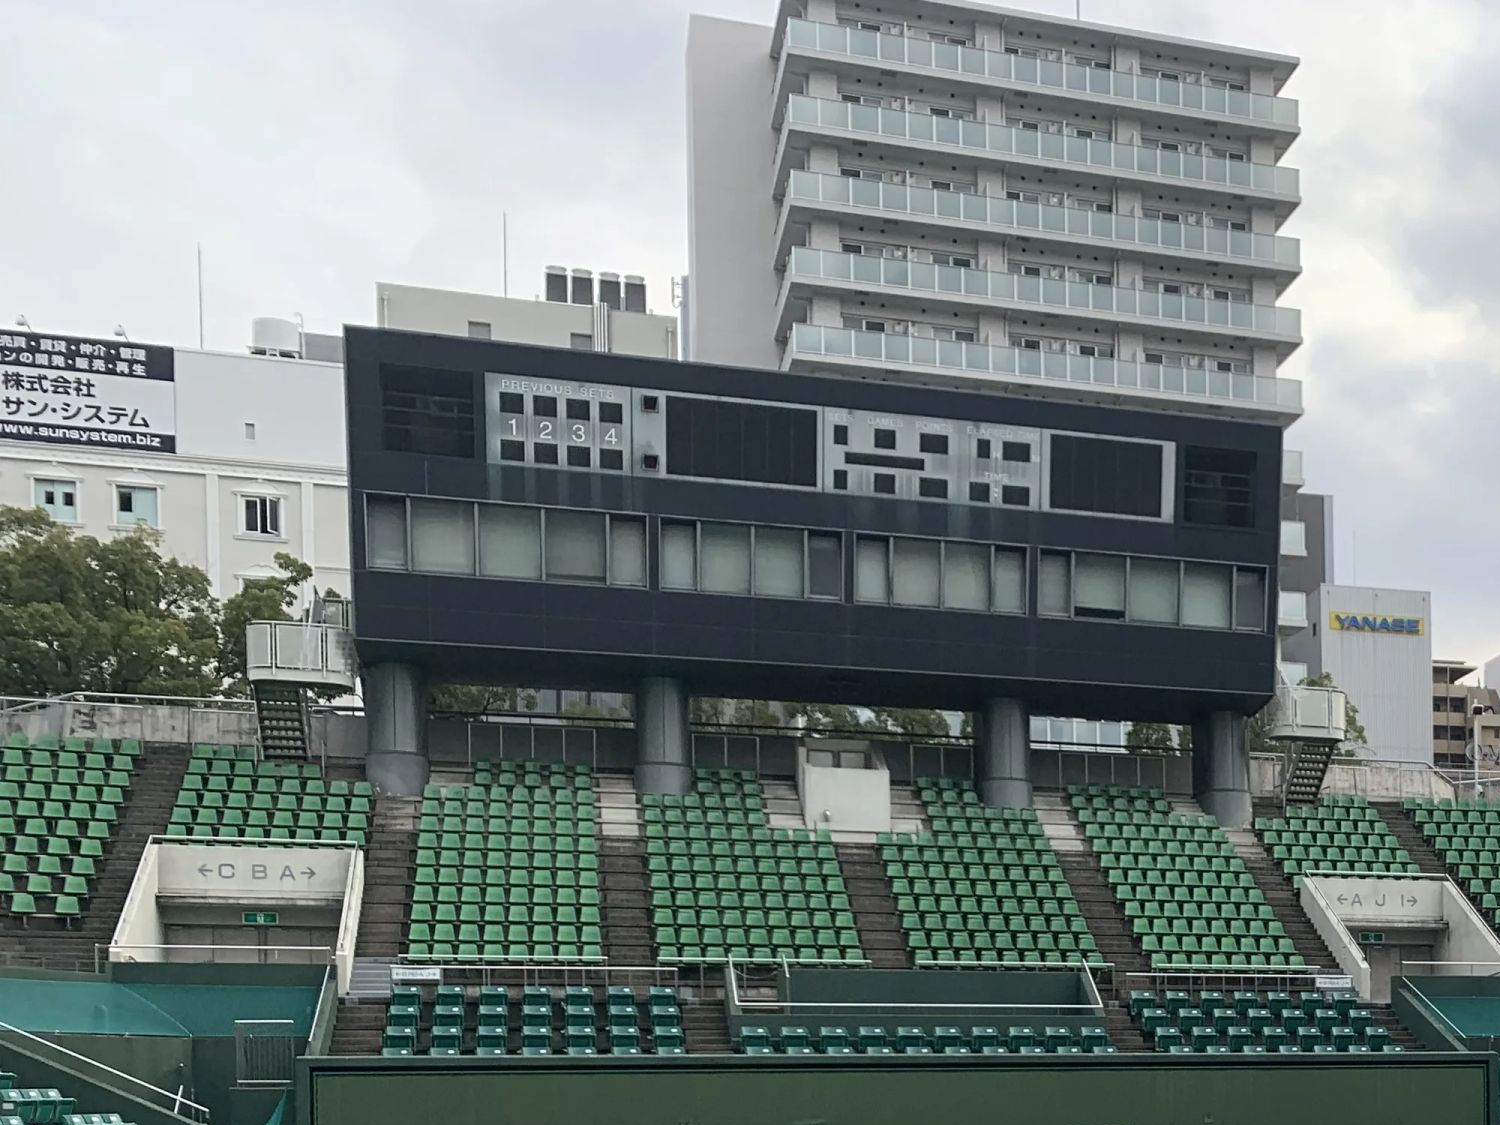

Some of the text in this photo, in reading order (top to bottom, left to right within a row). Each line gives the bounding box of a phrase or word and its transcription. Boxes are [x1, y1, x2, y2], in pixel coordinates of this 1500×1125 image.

[0, 350, 147, 376] ンの開発・販売・再生
[2, 370, 96, 398] 株式会社
[502, 380, 614, 400] PREVIOUS SETS
[2, 396, 150, 428] サン・システム
[508, 418, 617, 445] 1 2 3 4
[1335, 614, 1420, 633] YANASE
[218, 863, 296, 880] C B A
[1351, 893, 1362, 907] A
[1375, 894, 1386, 906] J
